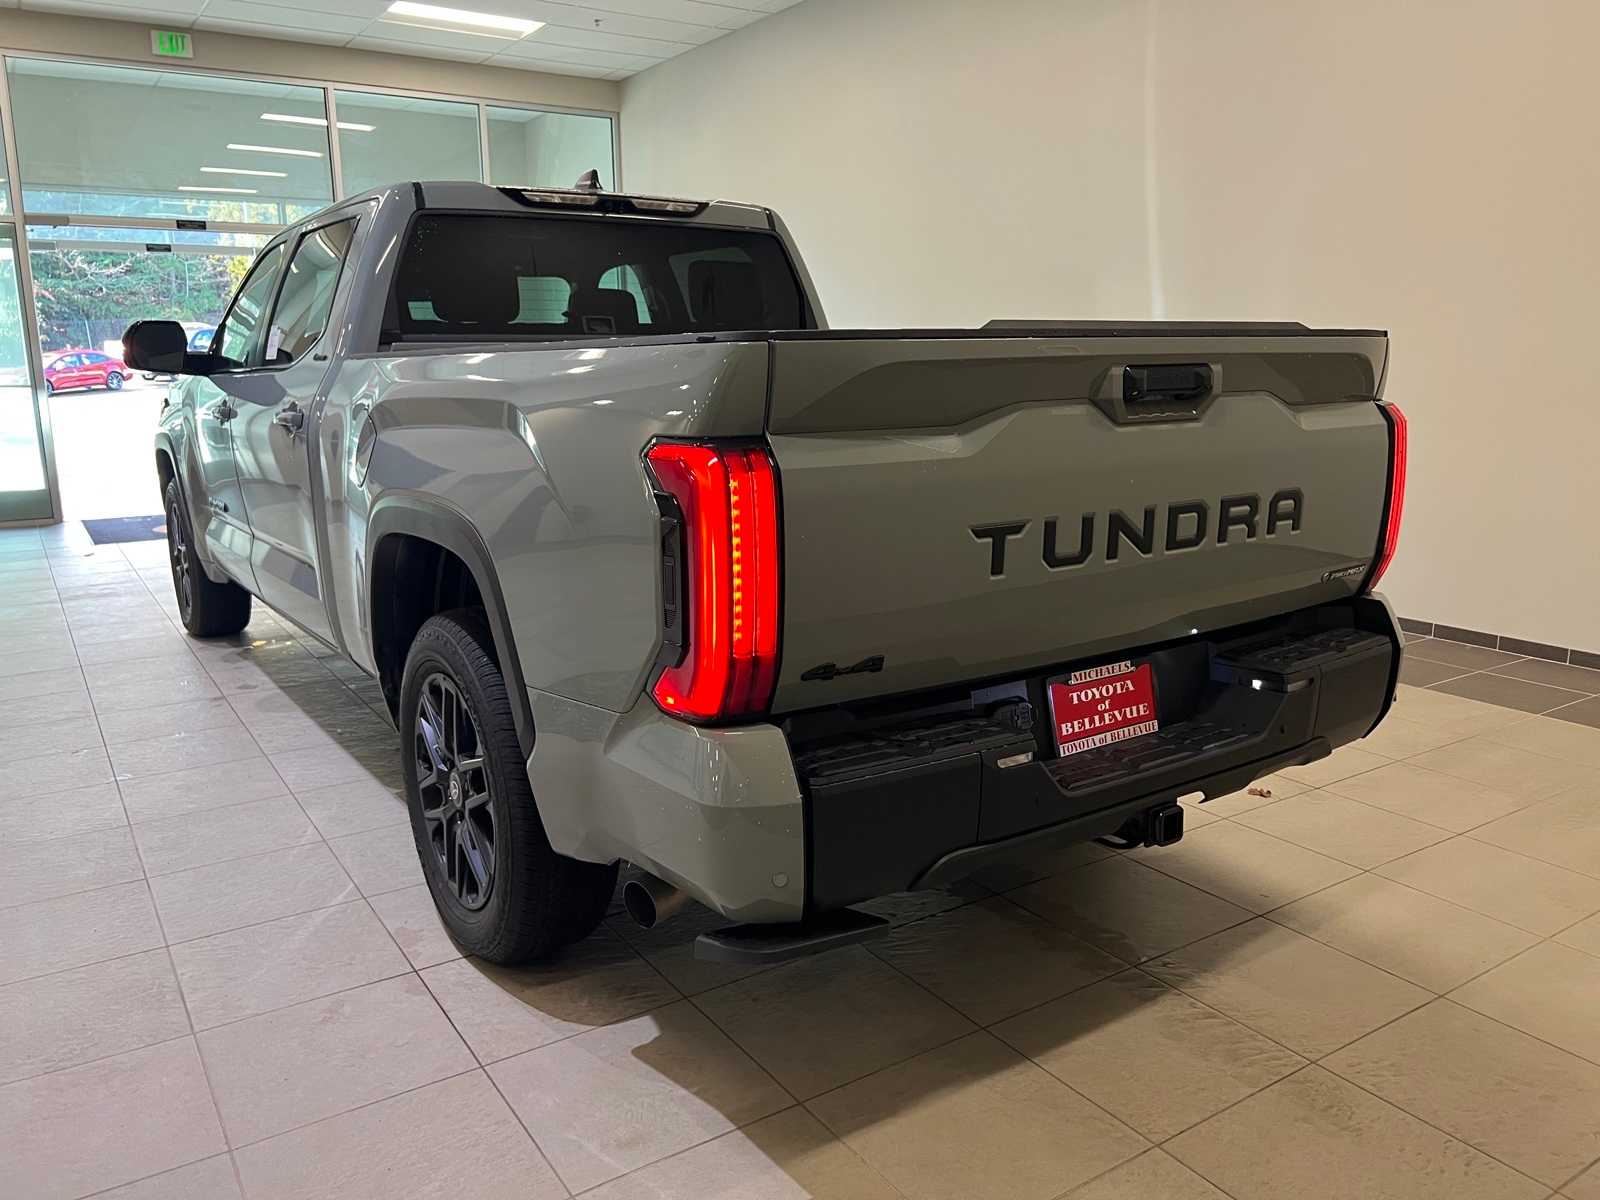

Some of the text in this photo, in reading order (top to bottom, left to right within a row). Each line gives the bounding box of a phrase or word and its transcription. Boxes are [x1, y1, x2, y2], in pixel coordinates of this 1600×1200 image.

[156, 31, 187, 55] EXIT
[968, 487, 1304, 580] TUNDRA
[1072, 662, 1131, 682] MICHAELS
[1069, 679, 1135, 705] TOYOTA
[1097, 699, 1111, 711] of
[1060, 703, 1150, 736] BELLEVUE
[1061, 721, 1157, 756] TOYOTA of BELLEVUE
